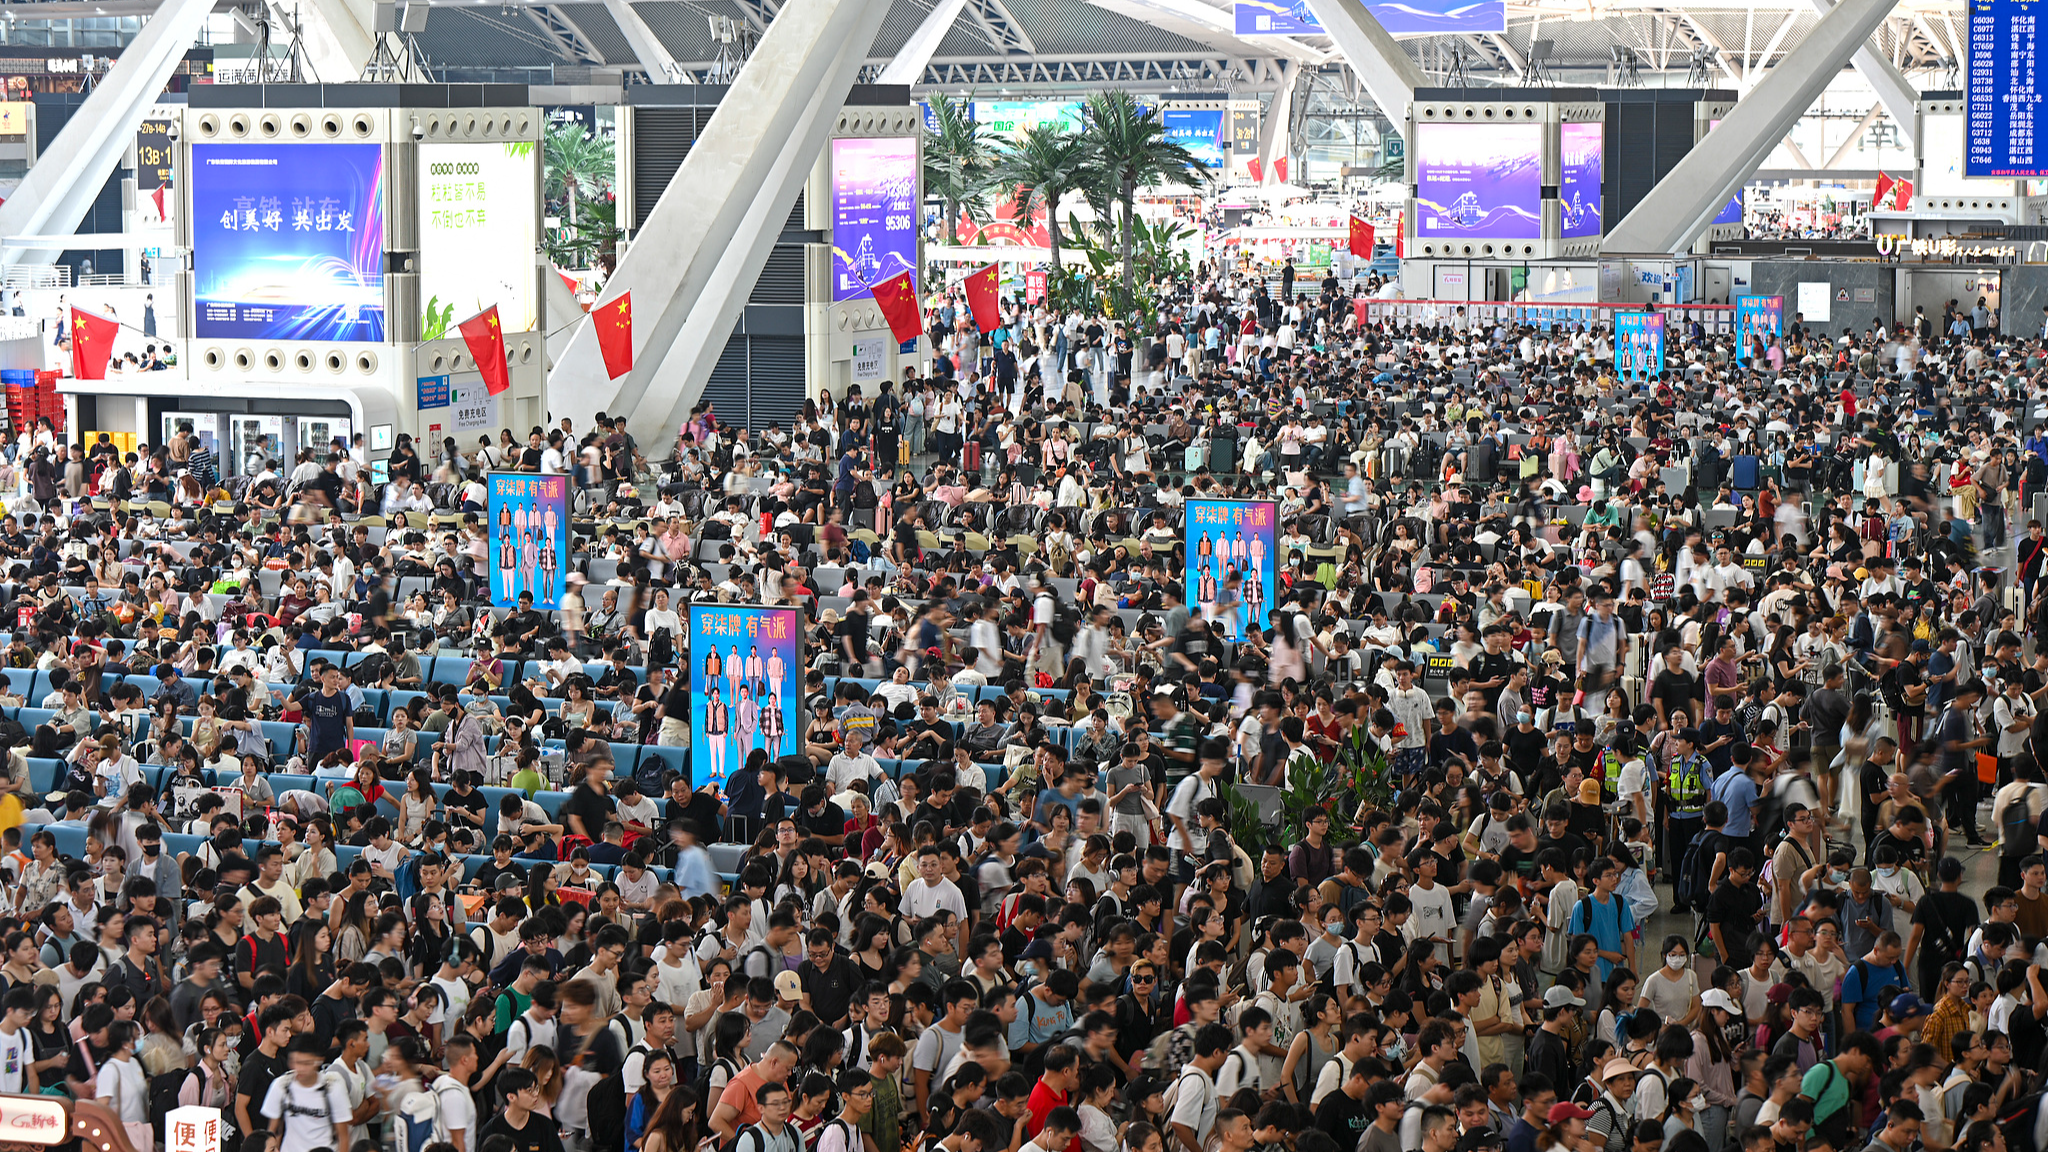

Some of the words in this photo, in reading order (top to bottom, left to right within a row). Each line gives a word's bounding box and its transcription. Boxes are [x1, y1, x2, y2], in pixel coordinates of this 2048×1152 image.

[2002, 94, 2042, 103] 香港西九龙
[431, 182, 485, 202] 粒粒皆不易
[220, 208, 283, 232] 创美好
[292, 209, 355, 232] 共出发
[431, 209, 486, 229] 不倒也不弃
[885, 215, 910, 231] 95306
[1896, 238, 1957, 256] 广铁U彩
[459, 407, 487, 420] 免费充电区
[495, 478, 525, 497] 穿柒牌
[528, 479, 558, 499] 有气派
[1194, 505, 1229, 525] 穿柒牌
[1232, 505, 1267, 526] 有气派
[701, 613, 741, 637] 穿柒牌
[745, 614, 787, 639] 有气派
